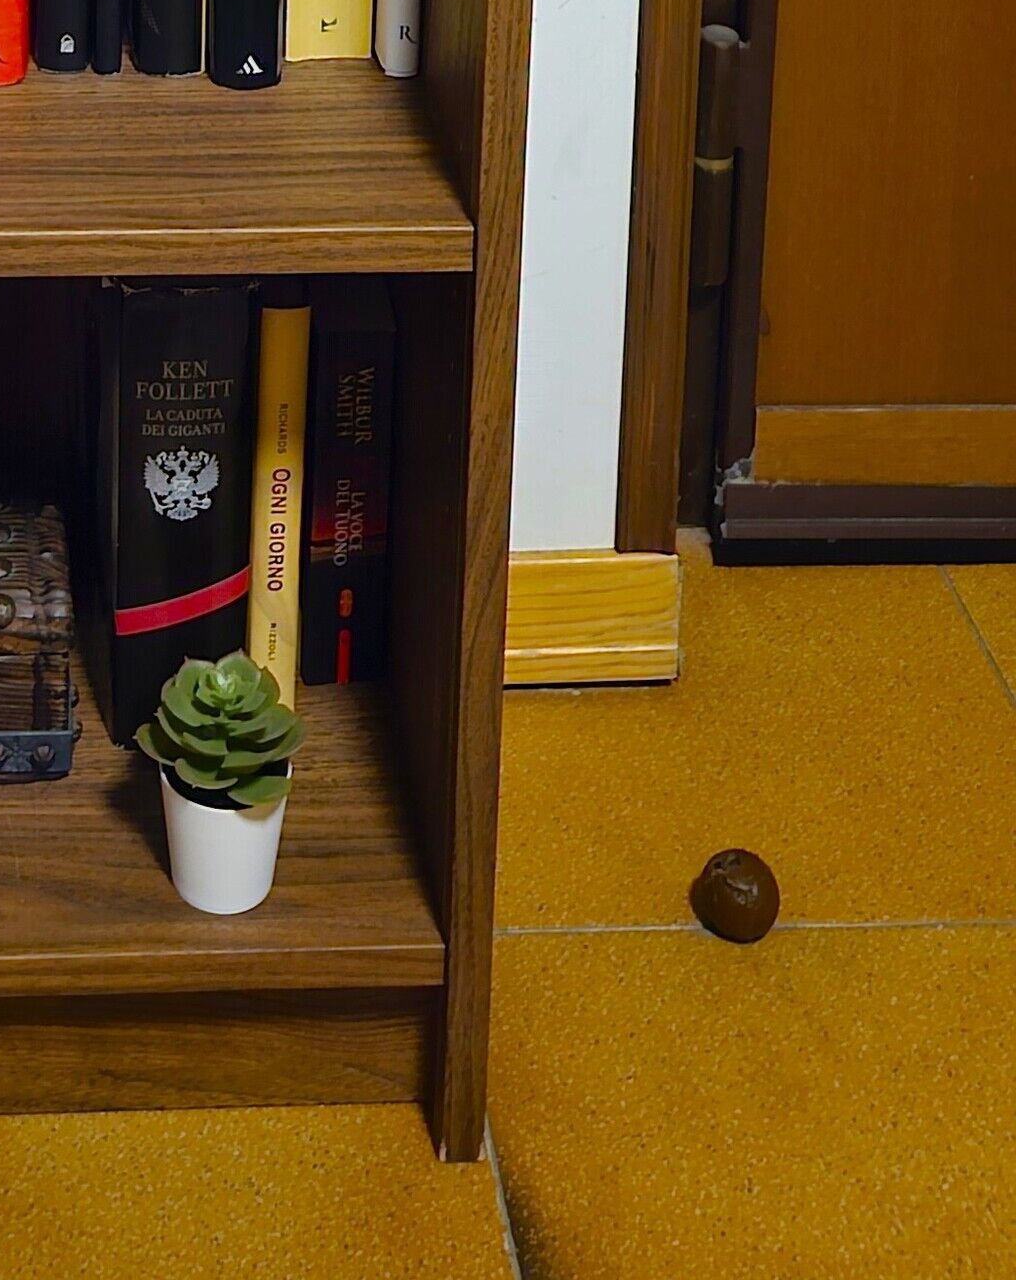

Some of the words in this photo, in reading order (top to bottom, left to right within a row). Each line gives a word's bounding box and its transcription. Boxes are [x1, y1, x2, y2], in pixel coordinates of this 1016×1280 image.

[399, 25, 417, 44] R
[162, 359, 209, 380] KEN
[136, 378, 234, 402] FOLLETT
[334, 374, 355, 438] SMITH
[353, 366, 376, 446] WILBUR
[141, 423, 166, 437] DEI
[167, 422, 226, 437] GIGANTI
[145, 407, 163, 423] LA
[165, 406, 223, 422] CADUTA
[276, 403, 289, 455] RICHARDS
[270, 468, 291, 515] OGNI
[334, 479, 351, 506] DEL
[349, 491, 366, 510] LA
[332, 509, 350, 567] TUONO
[347, 512, 365, 552] VOCE
[267, 523, 287, 592] GIORNO
